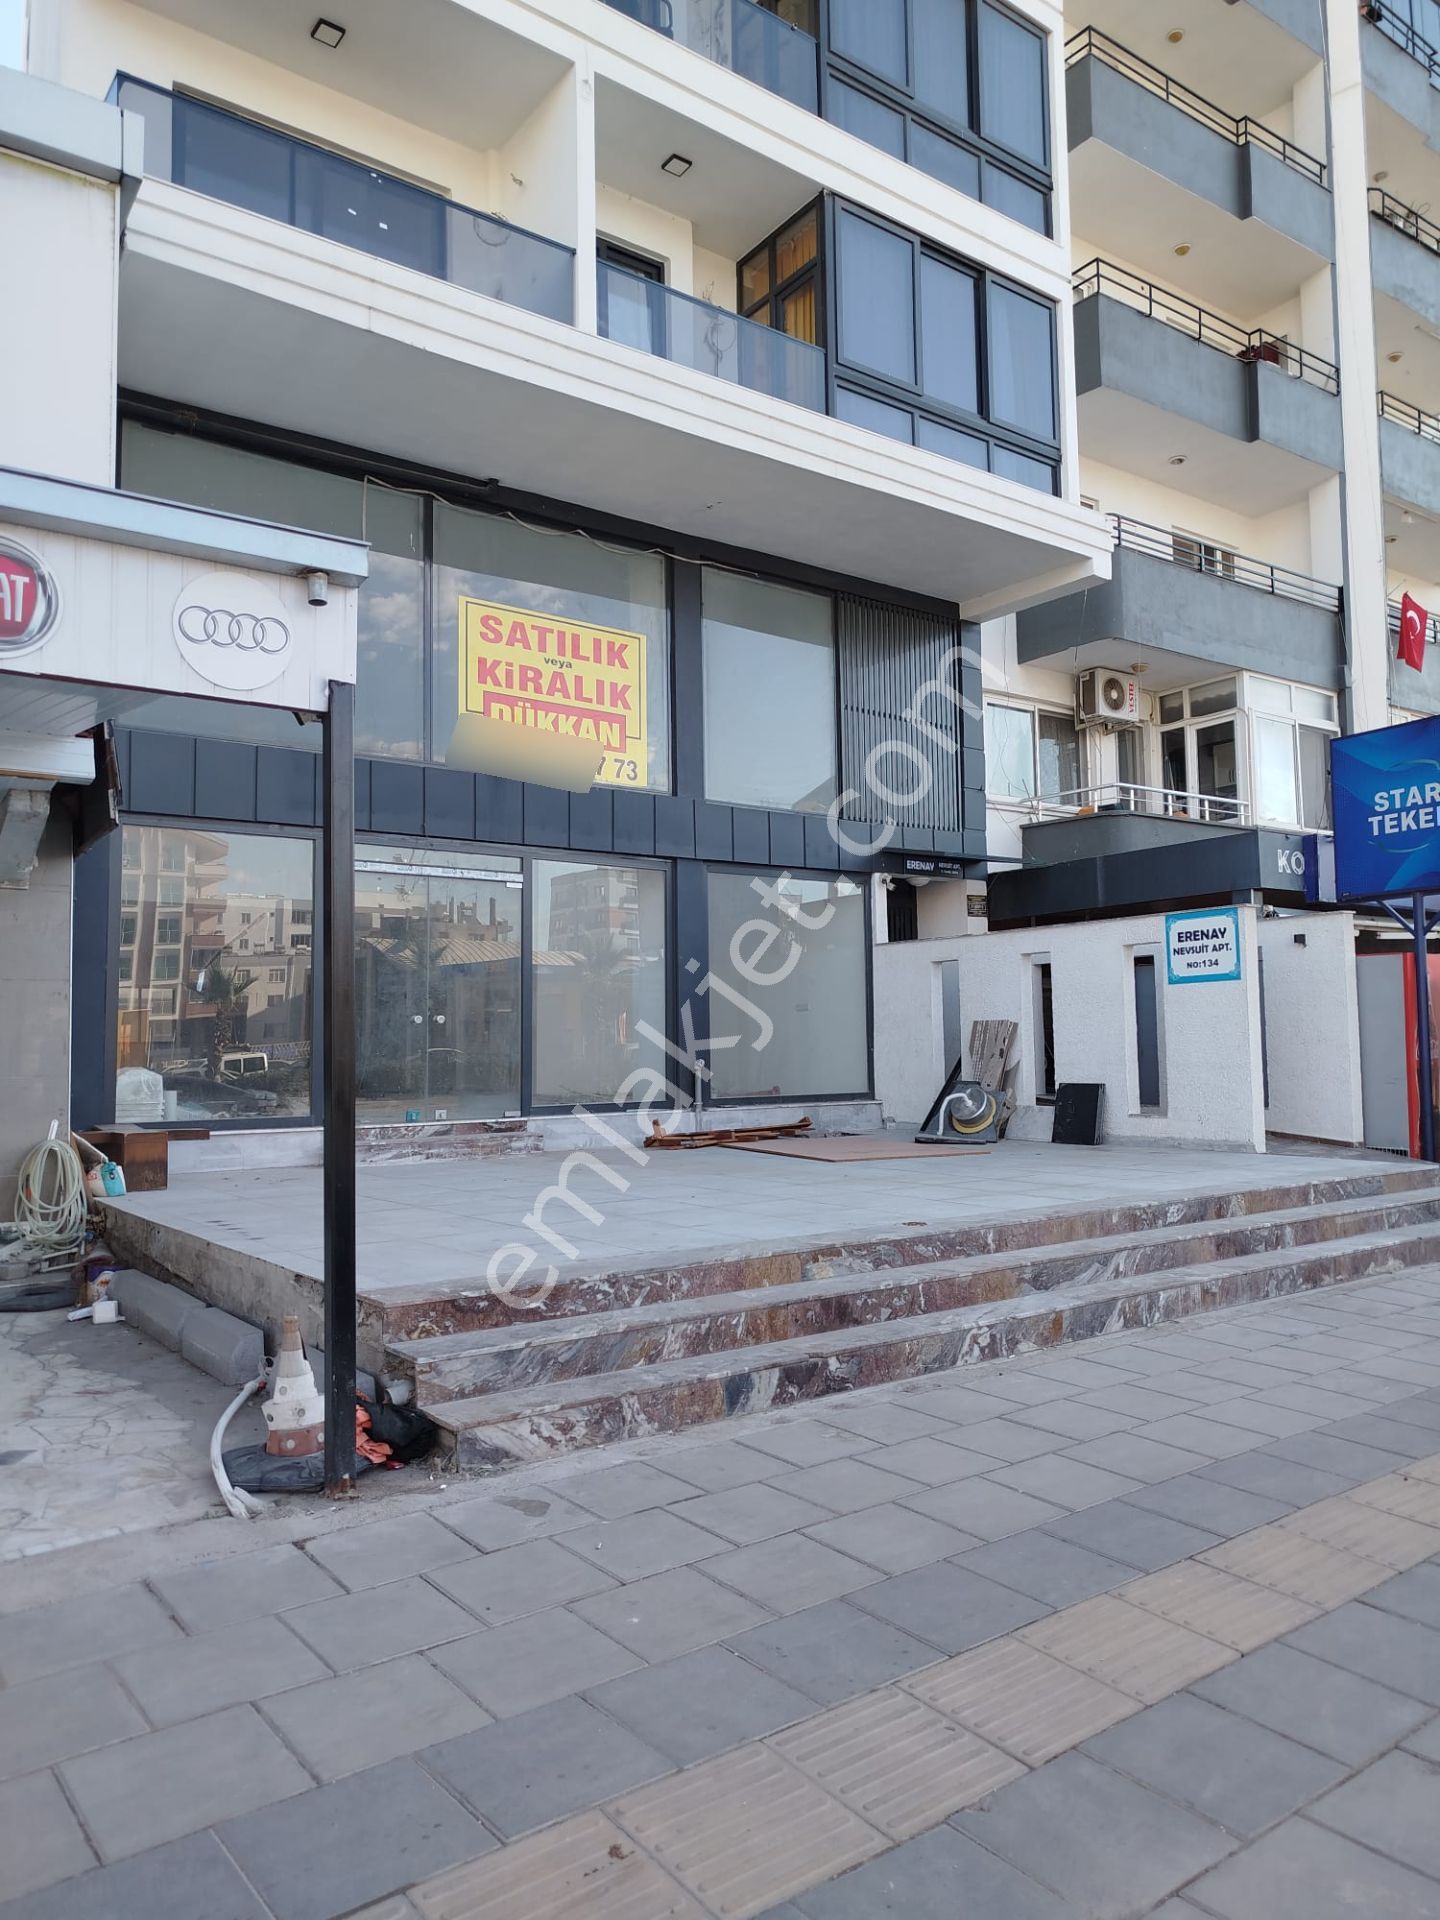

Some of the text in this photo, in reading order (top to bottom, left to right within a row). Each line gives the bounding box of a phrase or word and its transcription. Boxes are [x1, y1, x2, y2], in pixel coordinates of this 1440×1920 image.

[479, 614, 630, 670] SATILIK
[544, 657, 573, 669] veya
[490, 702, 620, 748] DÜKKAN
[613, 758, 638, 781] 73
[1374, 782, 1440, 812] STAR
[1368, 805, 1440, 836] TEKE
[906, 859, 935, 872] ERENAY
[1177, 927, 1227, 943] ERENAY
[1211, 943, 1232, 953] APT.
